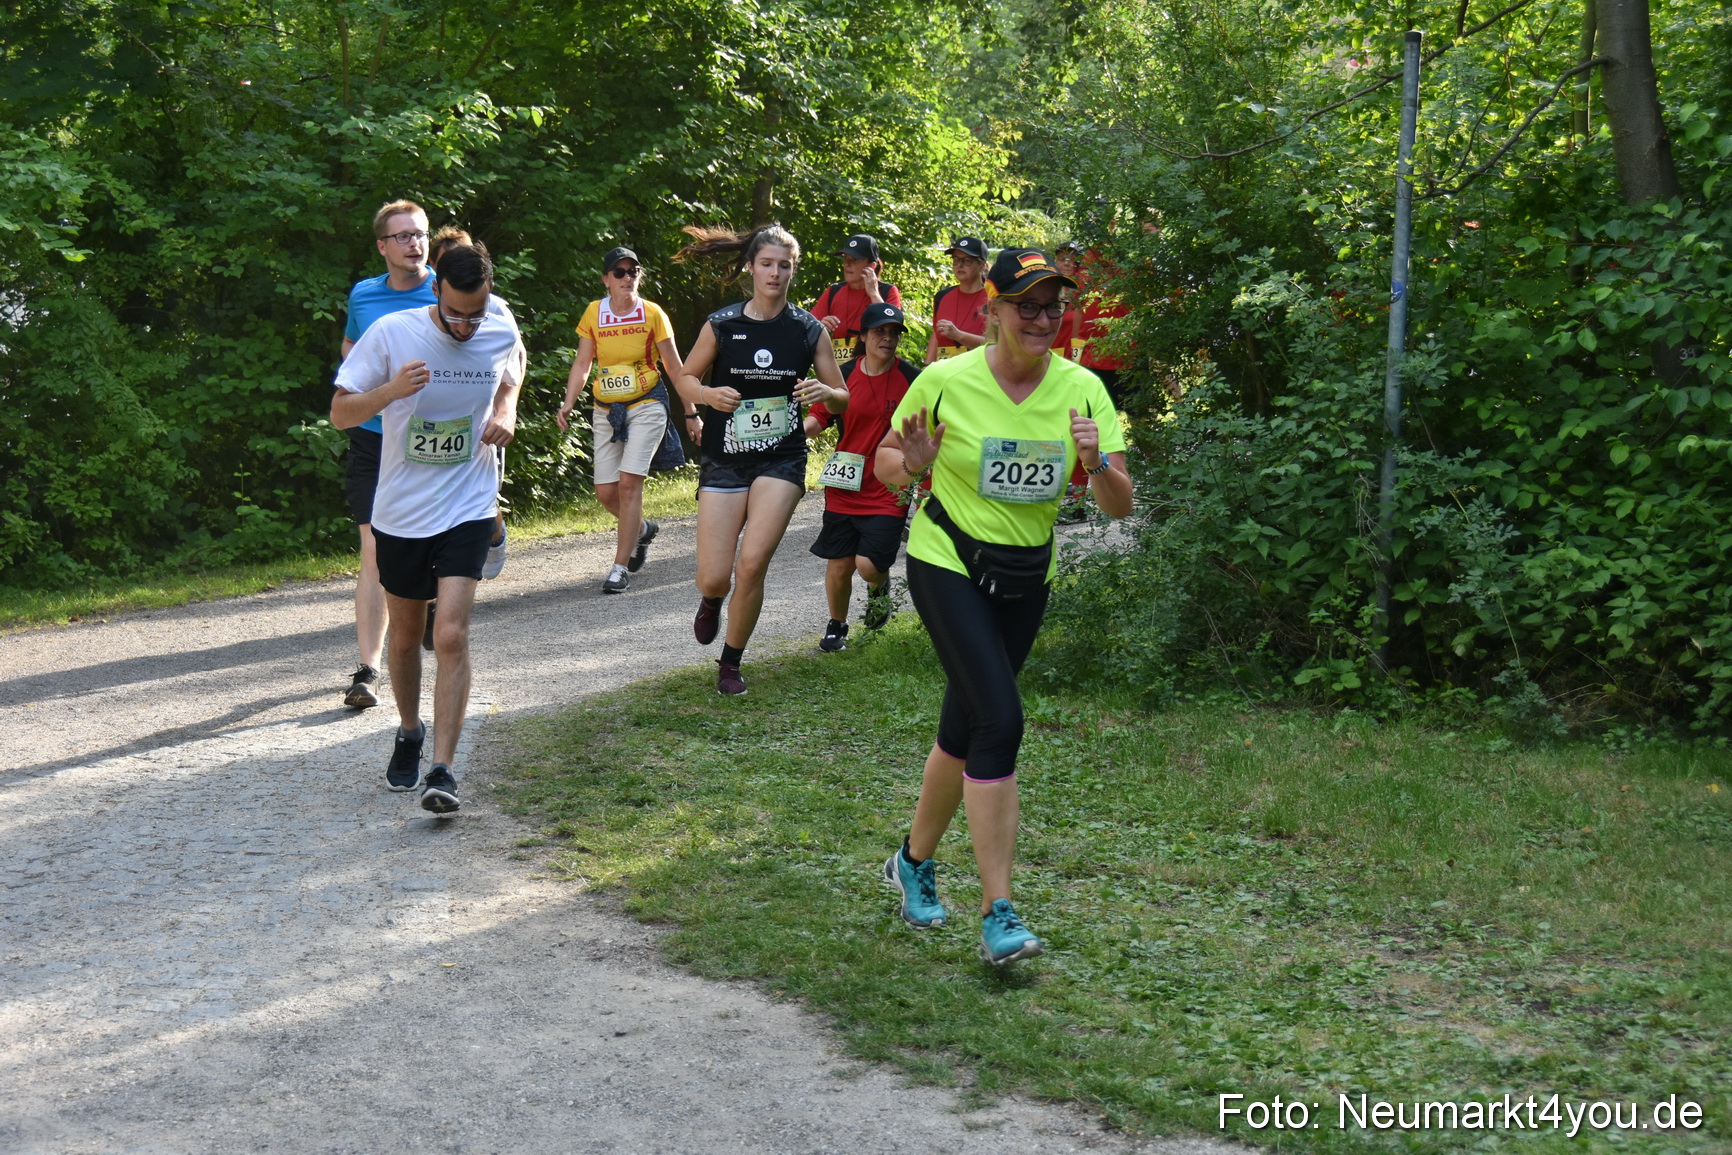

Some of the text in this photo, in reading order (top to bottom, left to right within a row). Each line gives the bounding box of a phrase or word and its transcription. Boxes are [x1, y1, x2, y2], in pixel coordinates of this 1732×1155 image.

[598, 329, 619, 338] MAX
[622, 326, 648, 336] BÖGL
[433, 370, 497, 378] SCHWARZ
[601, 375, 631, 389] 1666
[751, 412, 772, 428] 94
[414, 434, 465, 453] 2140
[823, 463, 856, 480] 2343
[989, 461, 1054, 486] 2023
[998, 485, 1045, 494] Margit Wagner
